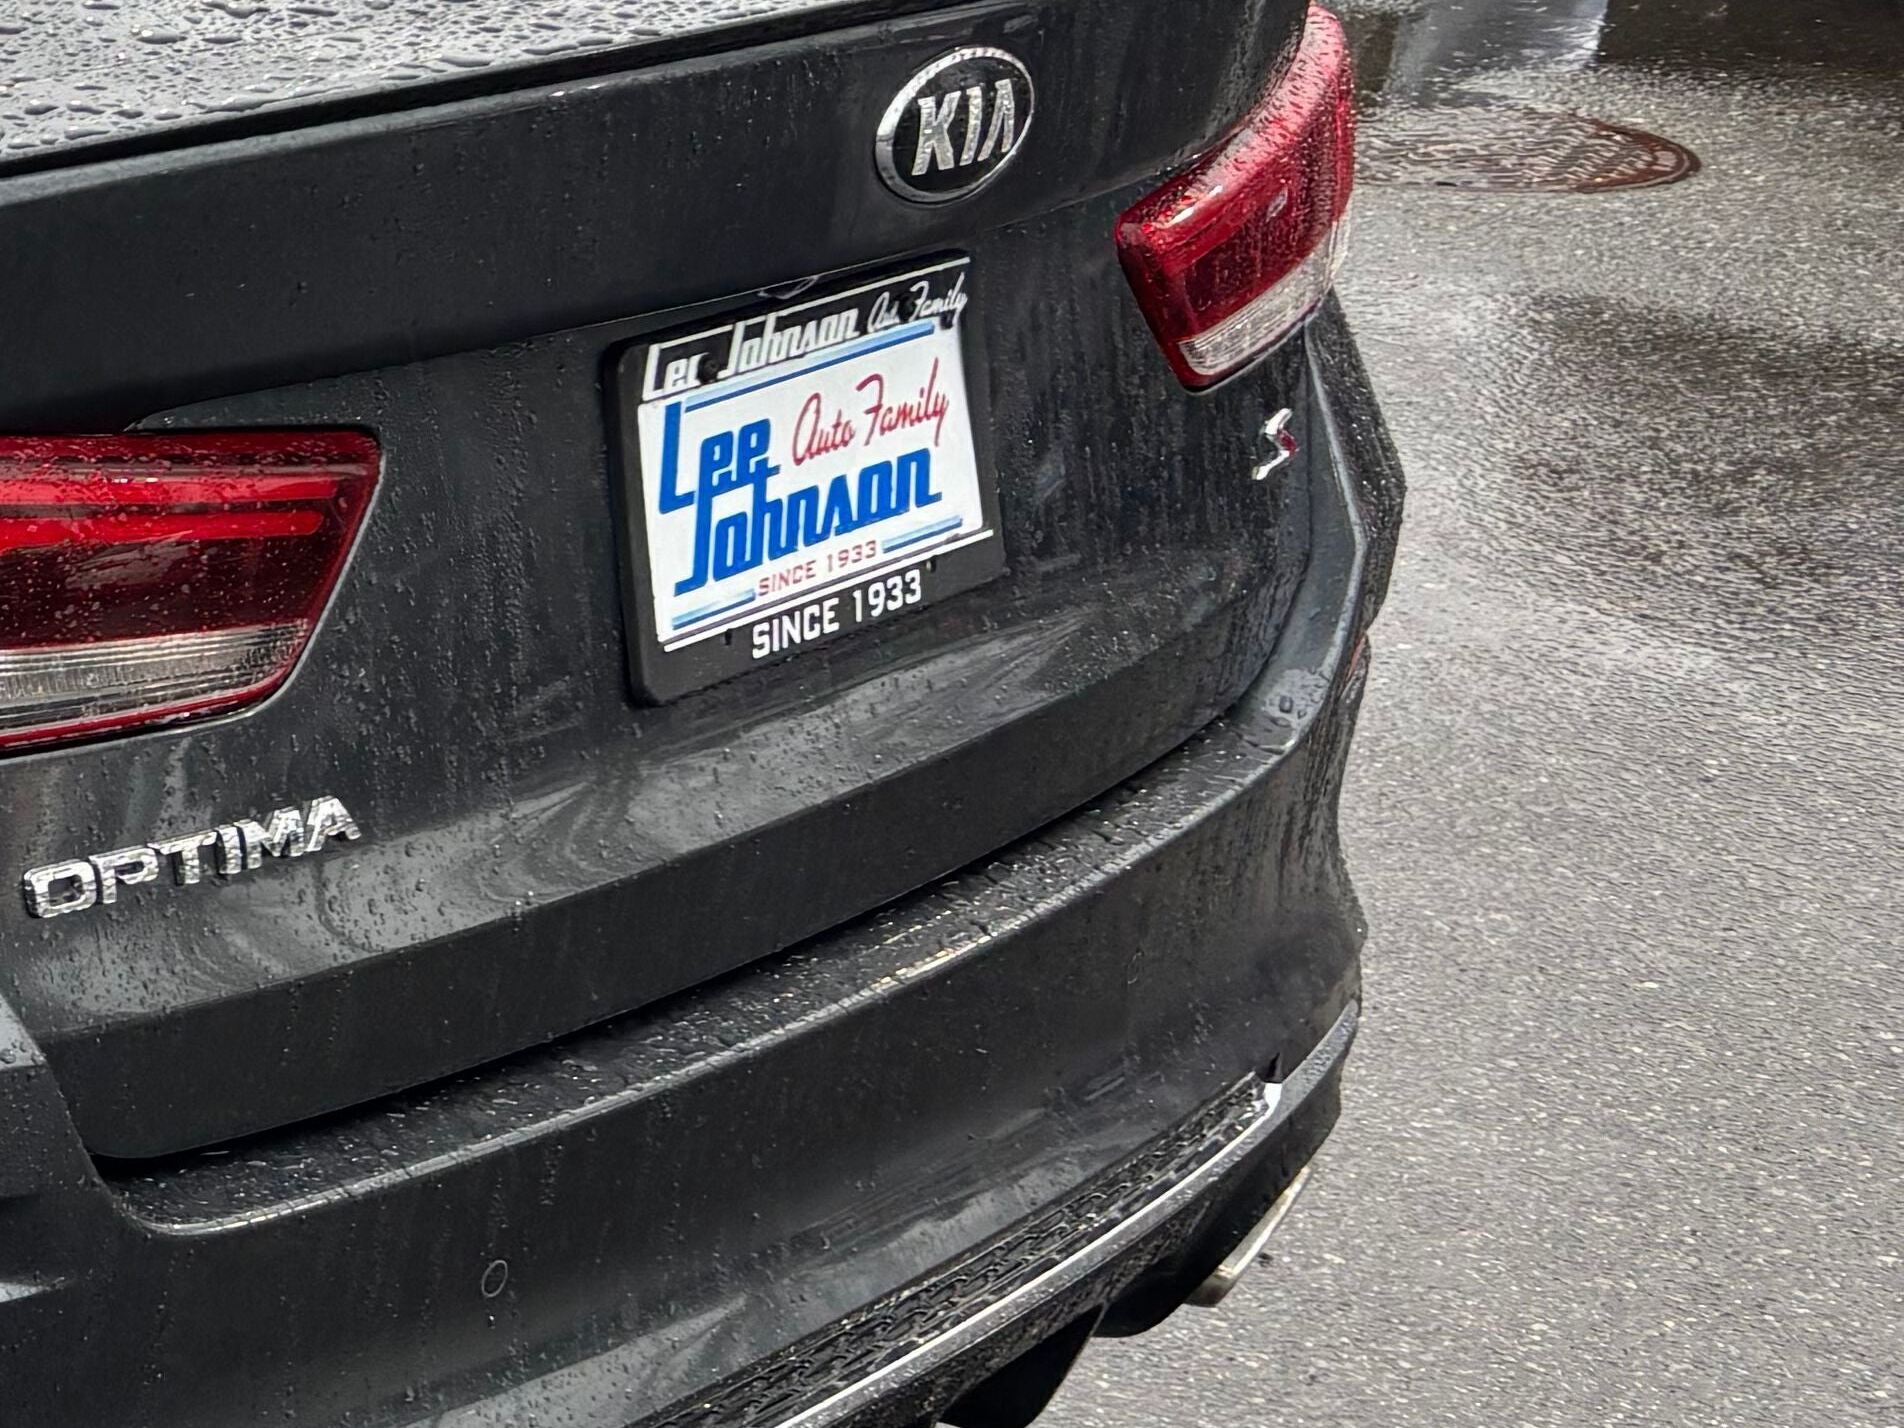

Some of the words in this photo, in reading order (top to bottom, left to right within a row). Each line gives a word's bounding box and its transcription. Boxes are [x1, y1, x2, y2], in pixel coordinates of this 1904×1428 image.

[910, 78, 1016, 177] KIA
[716, 308, 860, 380] Johnson
[909, 272, 968, 329] Family
[659, 400, 781, 515] Lee
[792, 392, 855, 467] Auto
[855, 357, 949, 447] Family
[674, 448, 942, 597] Johnson
[758, 560, 817, 596] SINCE
[827, 539, 877, 573] 1933
[752, 597, 840, 659] SINCE
[853, 569, 922, 623] 1933
[23, 795, 362, 919] OPTIMA
